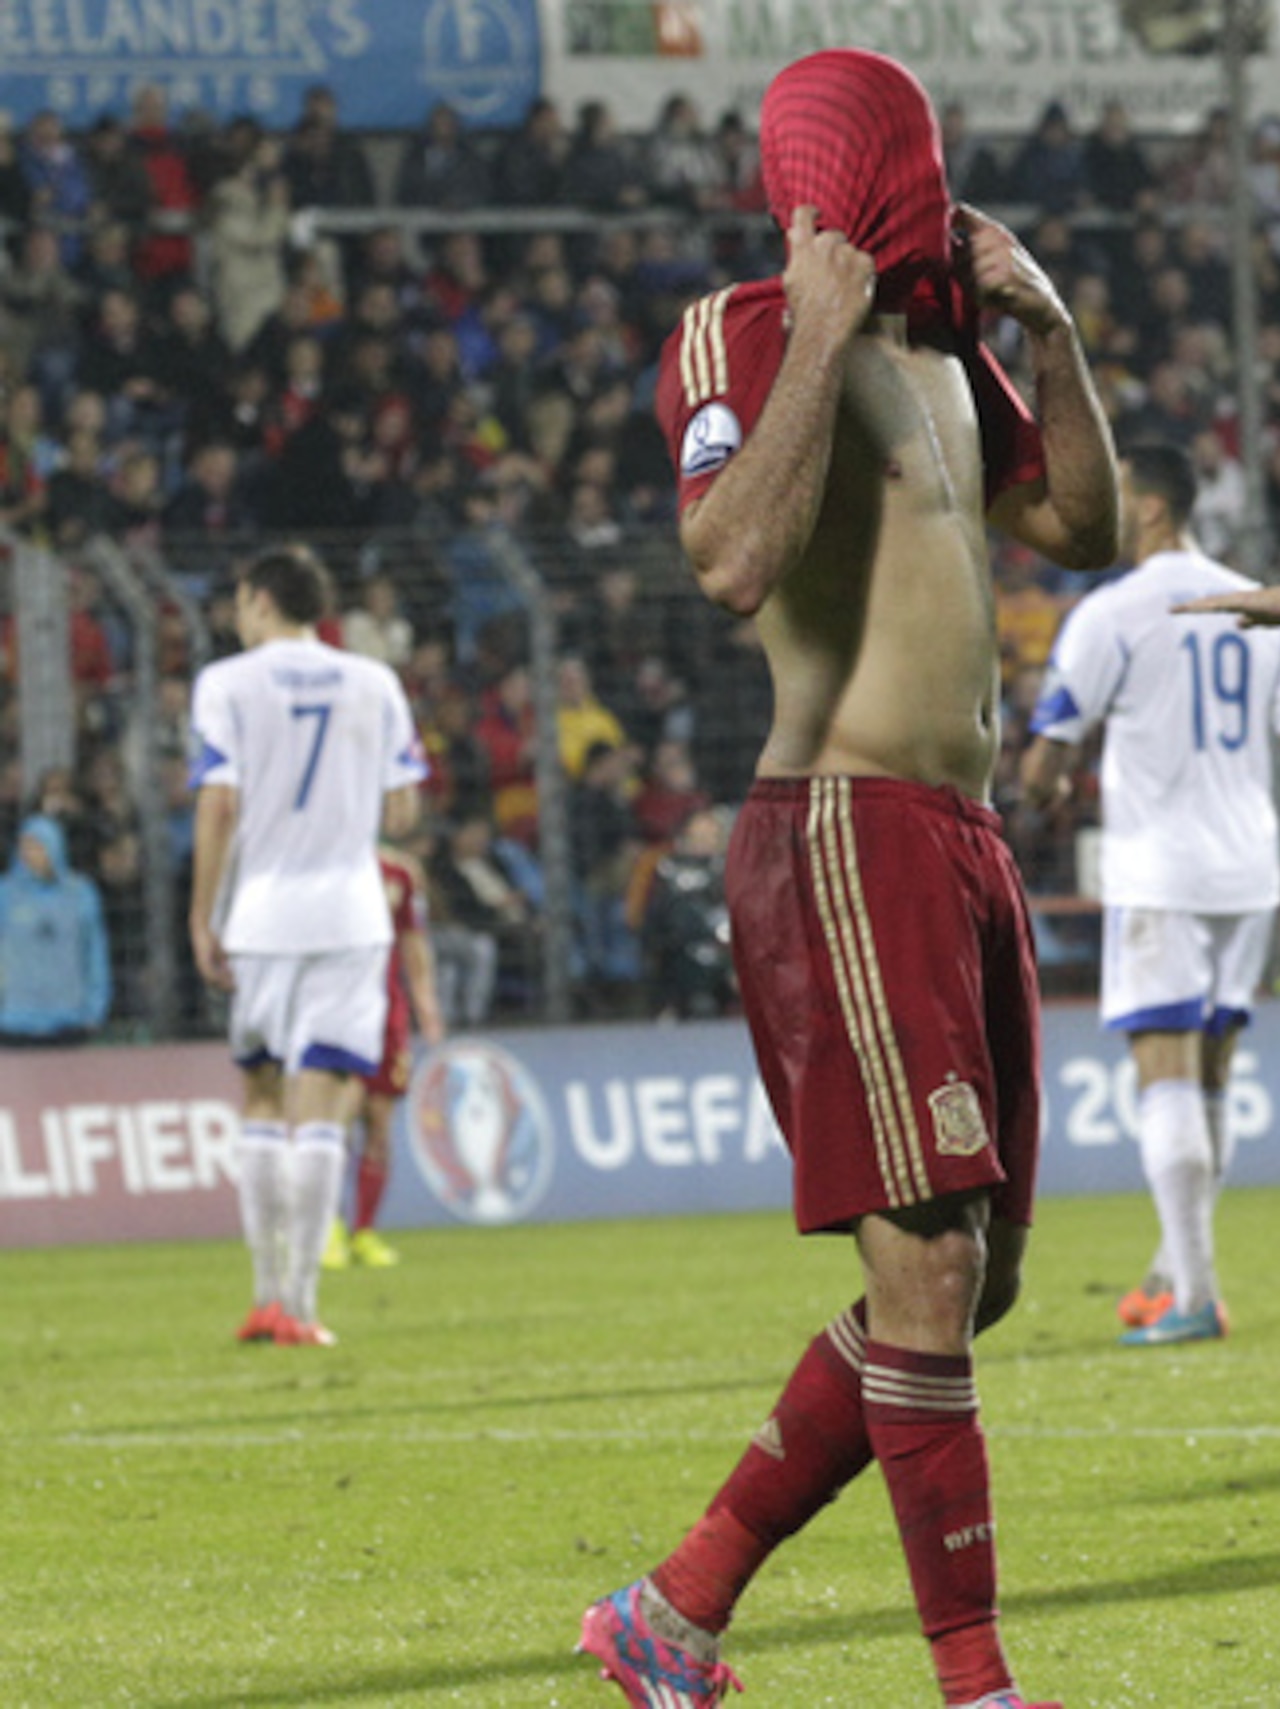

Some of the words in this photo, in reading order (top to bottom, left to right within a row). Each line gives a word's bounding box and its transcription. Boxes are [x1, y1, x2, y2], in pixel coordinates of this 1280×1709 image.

[1181, 630, 1251, 754] 19
[290, 703, 332, 813] 7
[0, 1098, 244, 1199] LIFIER
